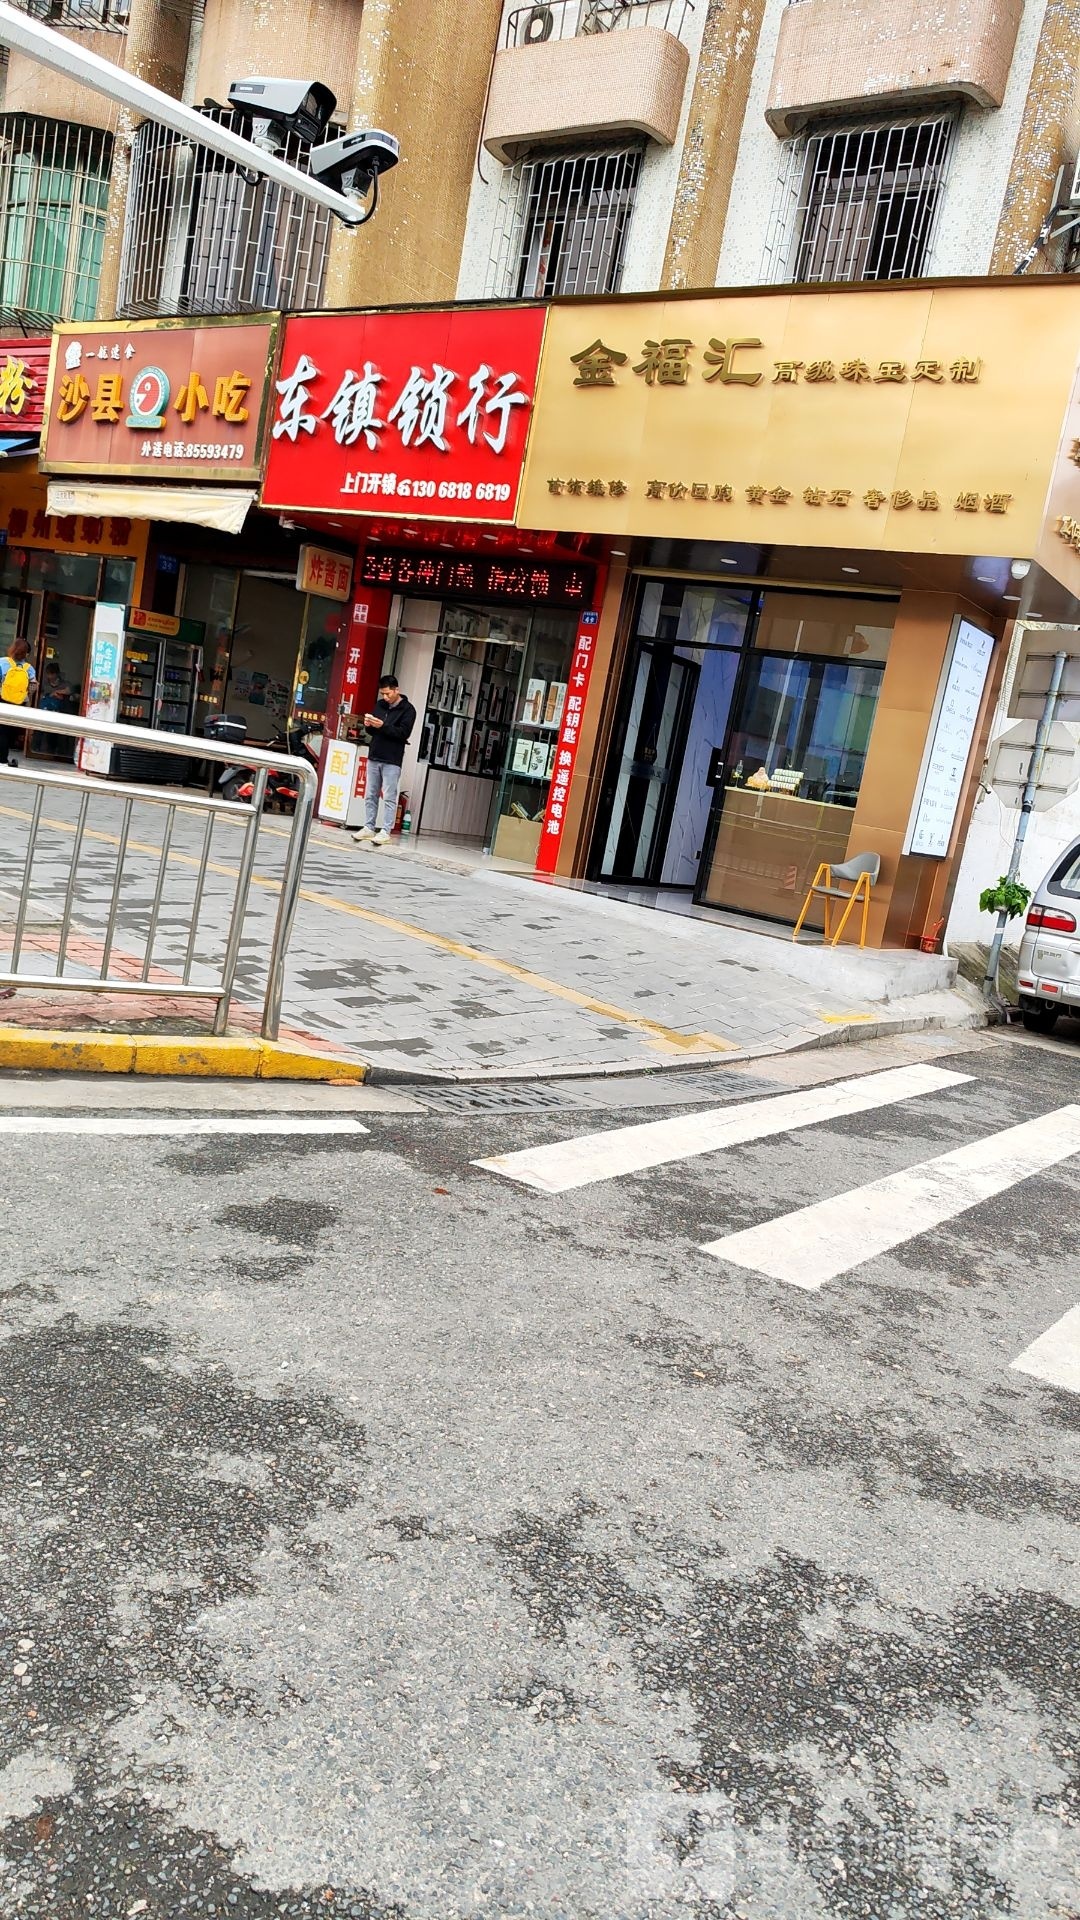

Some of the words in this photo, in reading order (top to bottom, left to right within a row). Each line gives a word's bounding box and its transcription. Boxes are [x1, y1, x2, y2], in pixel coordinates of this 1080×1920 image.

[569, 336, 765, 387] 金福汇
[770, 355, 984, 387] 高级珠宝定制
[56, 373, 125, 424] 沙县
[173, 370, 252, 424] 小吃
[272, 354, 528, 454] 东镇锁行
[340, 472, 398, 496] 上门开锁
[412, 480, 436, 498] 130
[438, 481, 472, 500] 6818
[475, 483, 511, 502] 6819
[547, 477, 629, 498] 首饰维修
[644, 479, 735, 503] 高价回购
[744, 483, 793, 506] 黄金
[802, 486, 854, 507] 钻石
[862, 488, 940, 511] 奢侈品
[953, 490, 1012, 514] 烟酒
[346, 647, 361, 685] 开锁
[572, 635, 592, 688] 配门卡
[562, 695, 583, 744] 配钥匙
[547, 751, 572, 835] 换遥控电池
